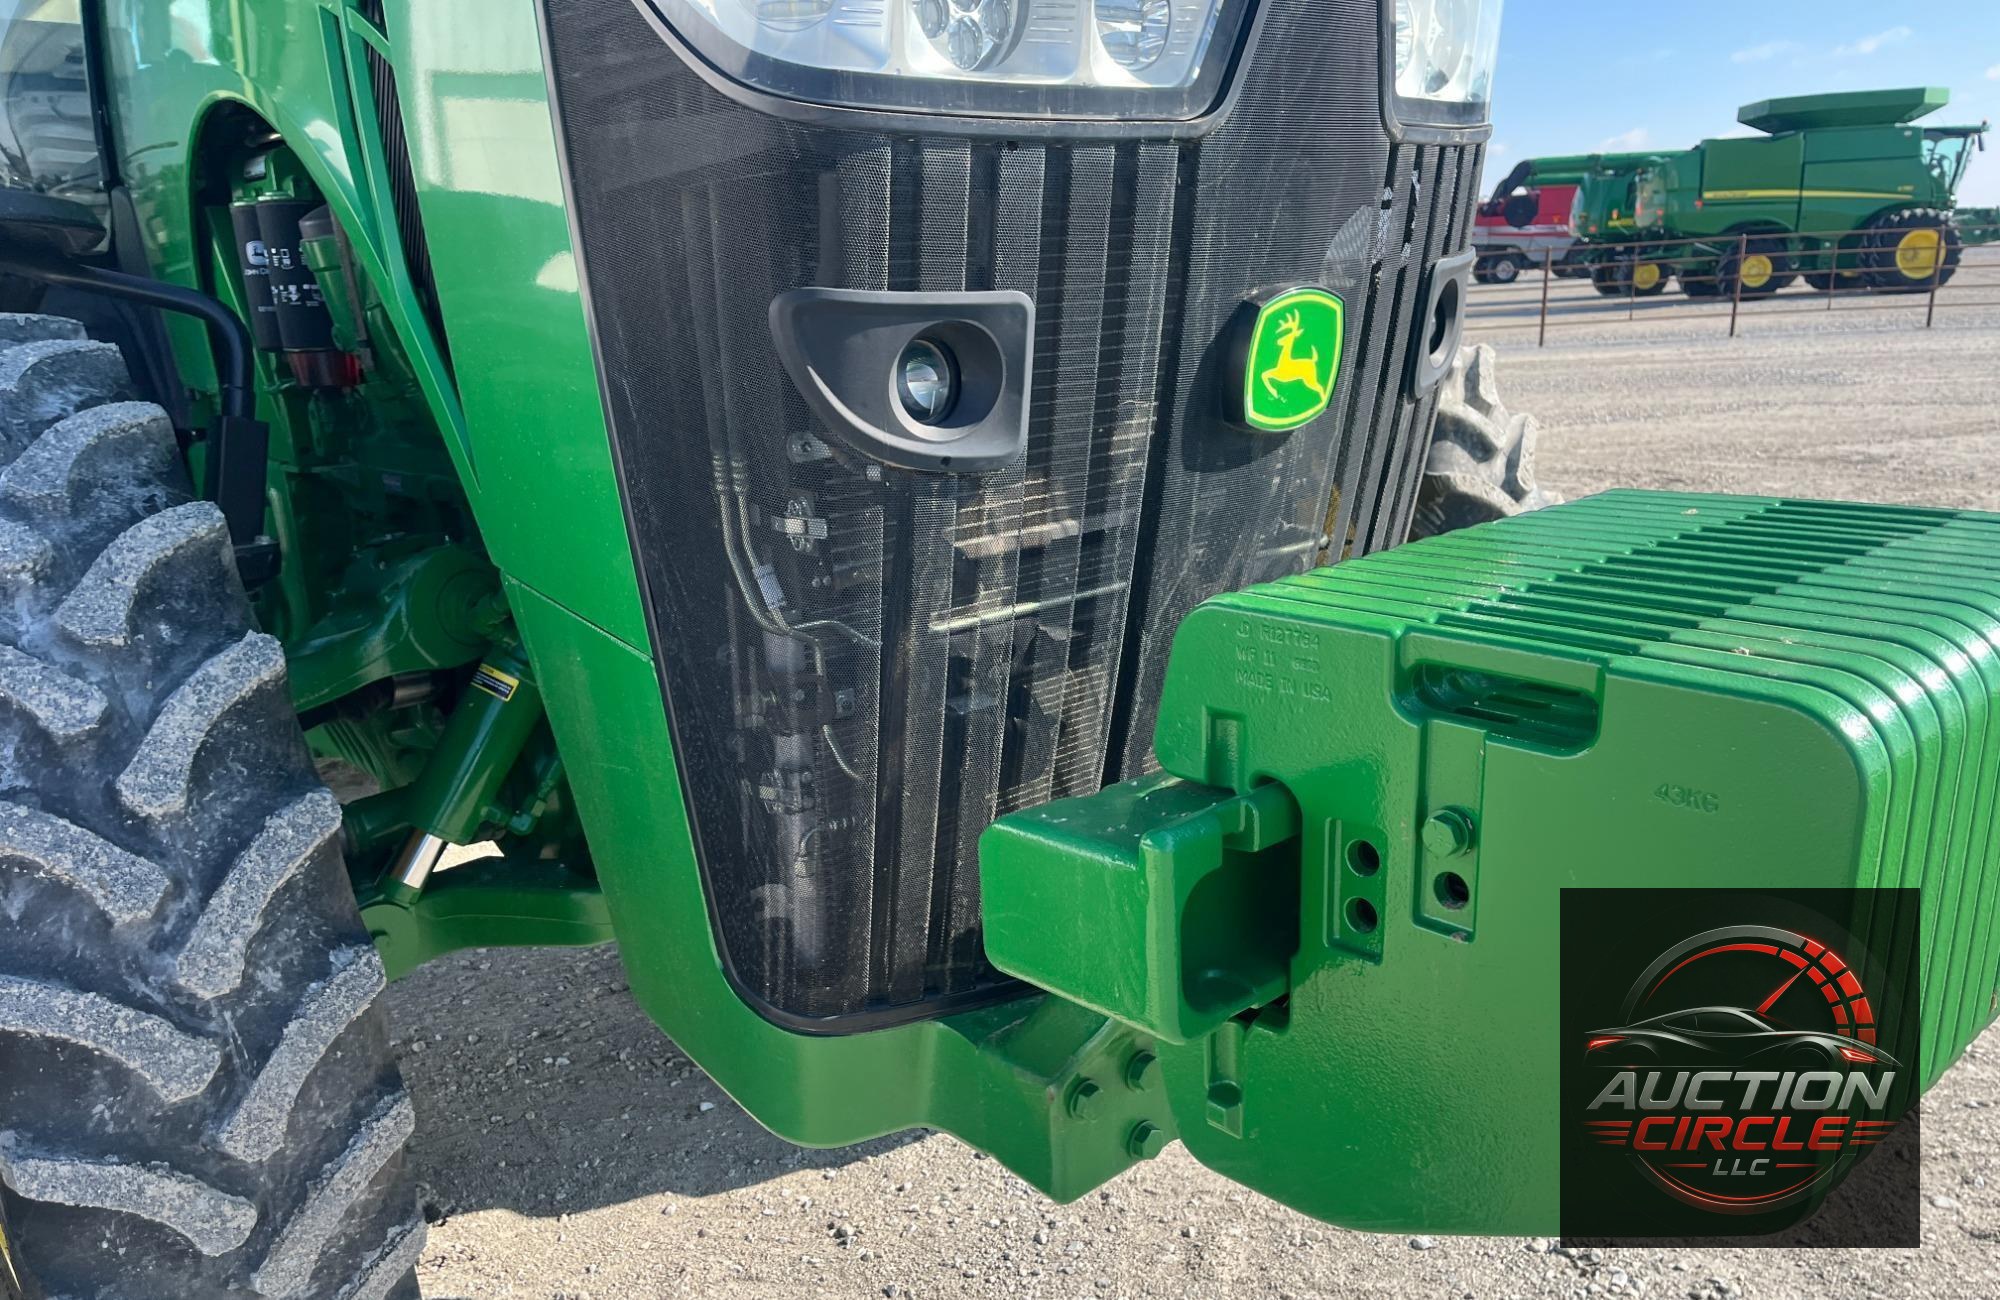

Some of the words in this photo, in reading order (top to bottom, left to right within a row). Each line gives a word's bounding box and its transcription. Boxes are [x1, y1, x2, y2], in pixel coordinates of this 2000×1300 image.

[1235, 668, 1274, 691] MADE
[1279, 675, 1297, 696] IN
[1303, 681, 1333, 704] USA
[1654, 783, 1720, 814] 43KG
